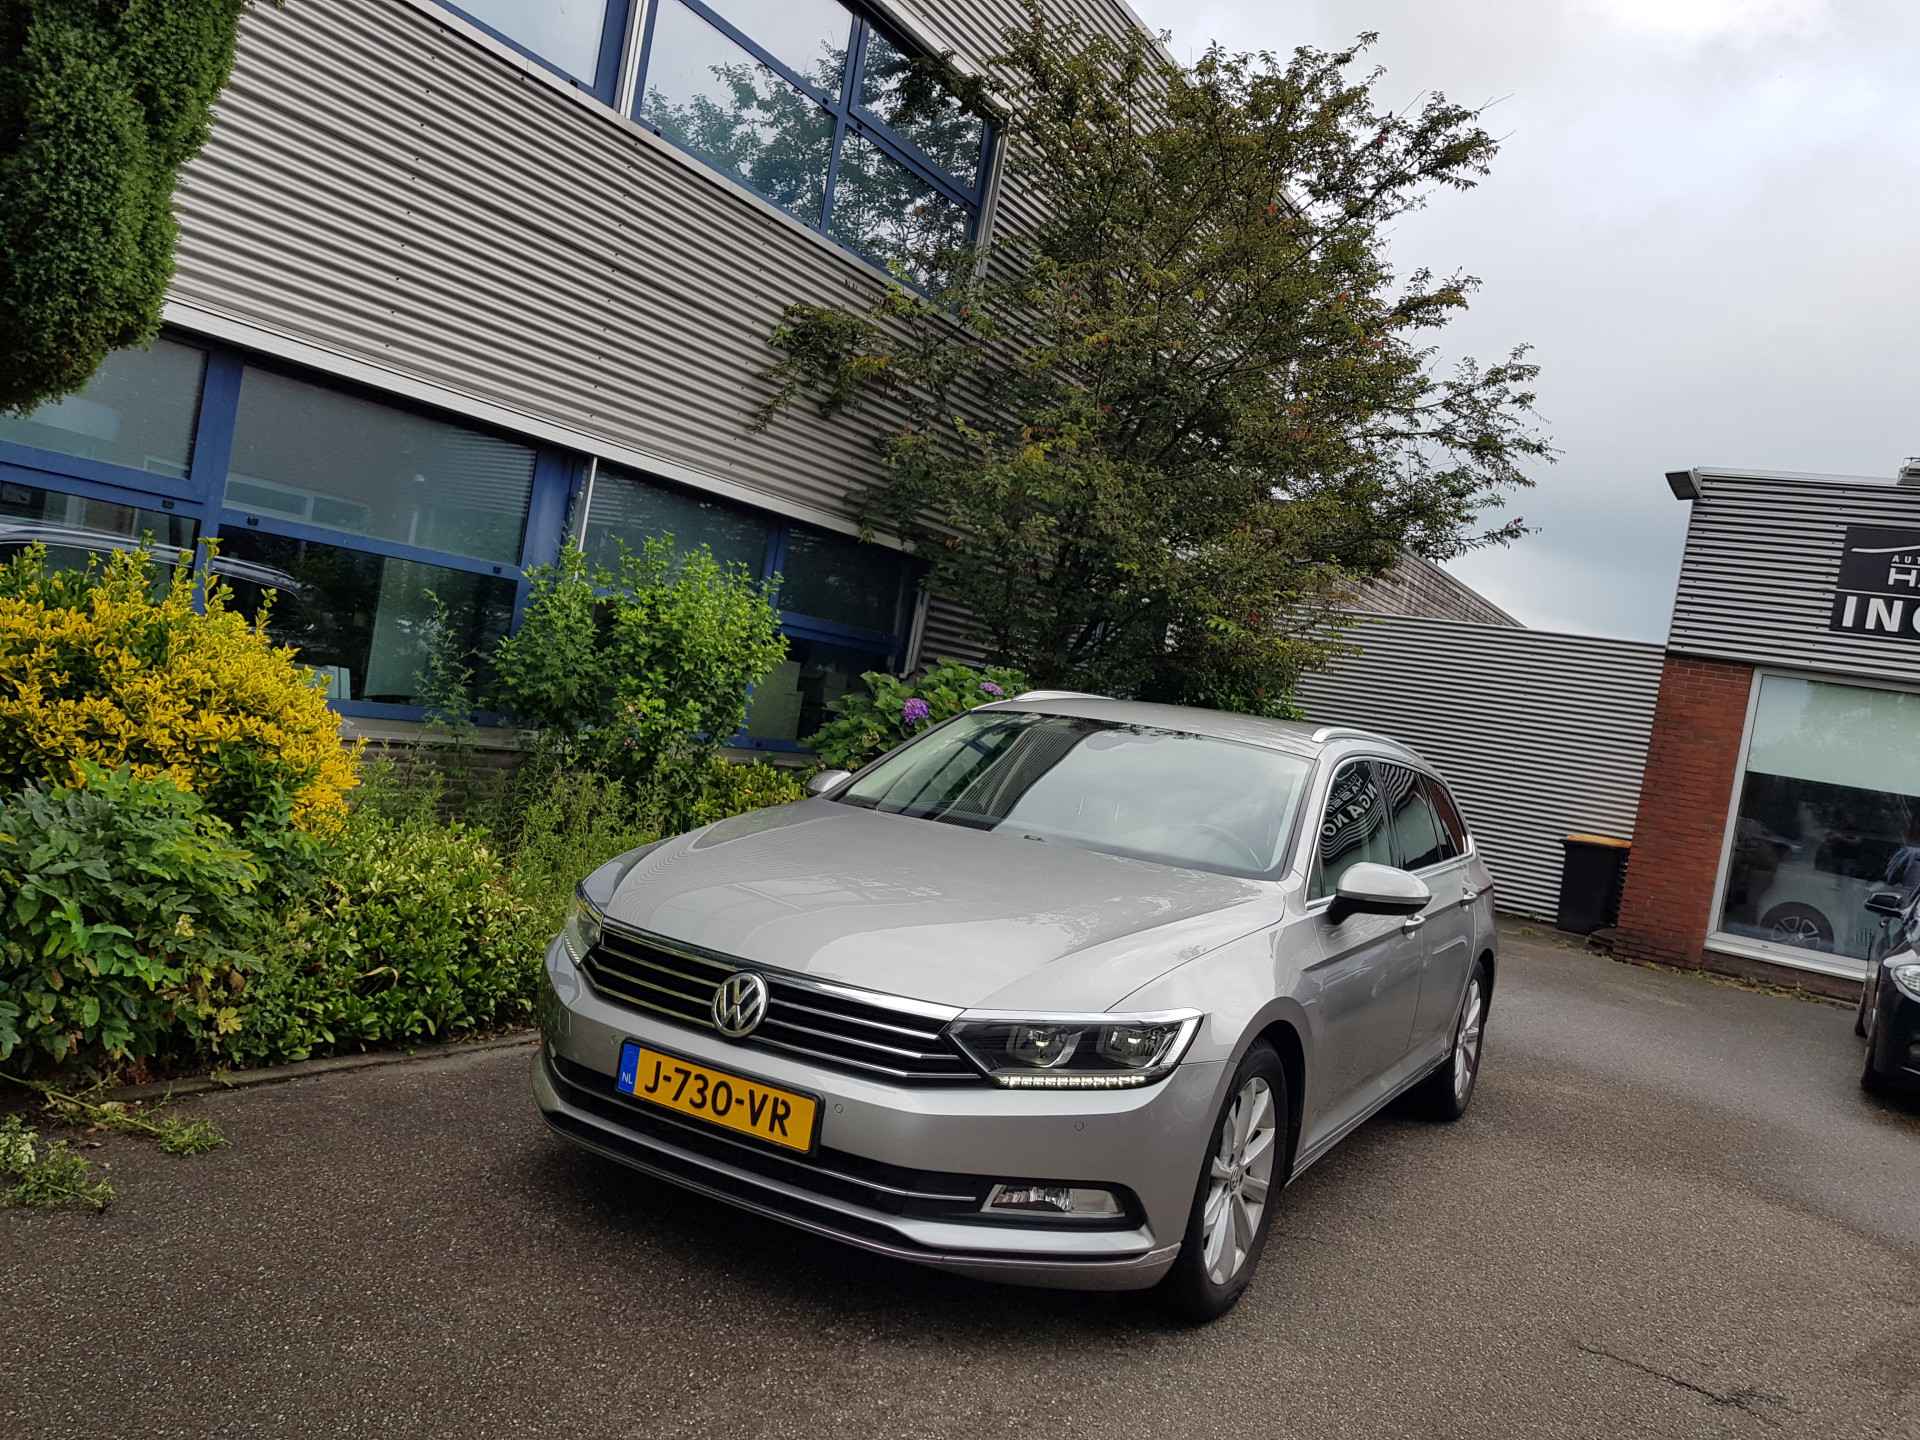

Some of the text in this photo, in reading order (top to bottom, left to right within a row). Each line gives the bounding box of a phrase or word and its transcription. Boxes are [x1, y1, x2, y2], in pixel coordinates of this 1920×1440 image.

[1888, 567, 1920, 588] H
[1842, 595, 1920, 634] IN
[621, 1071, 633, 1085] NL
[644, 1060, 792, 1137] J-730-VR
